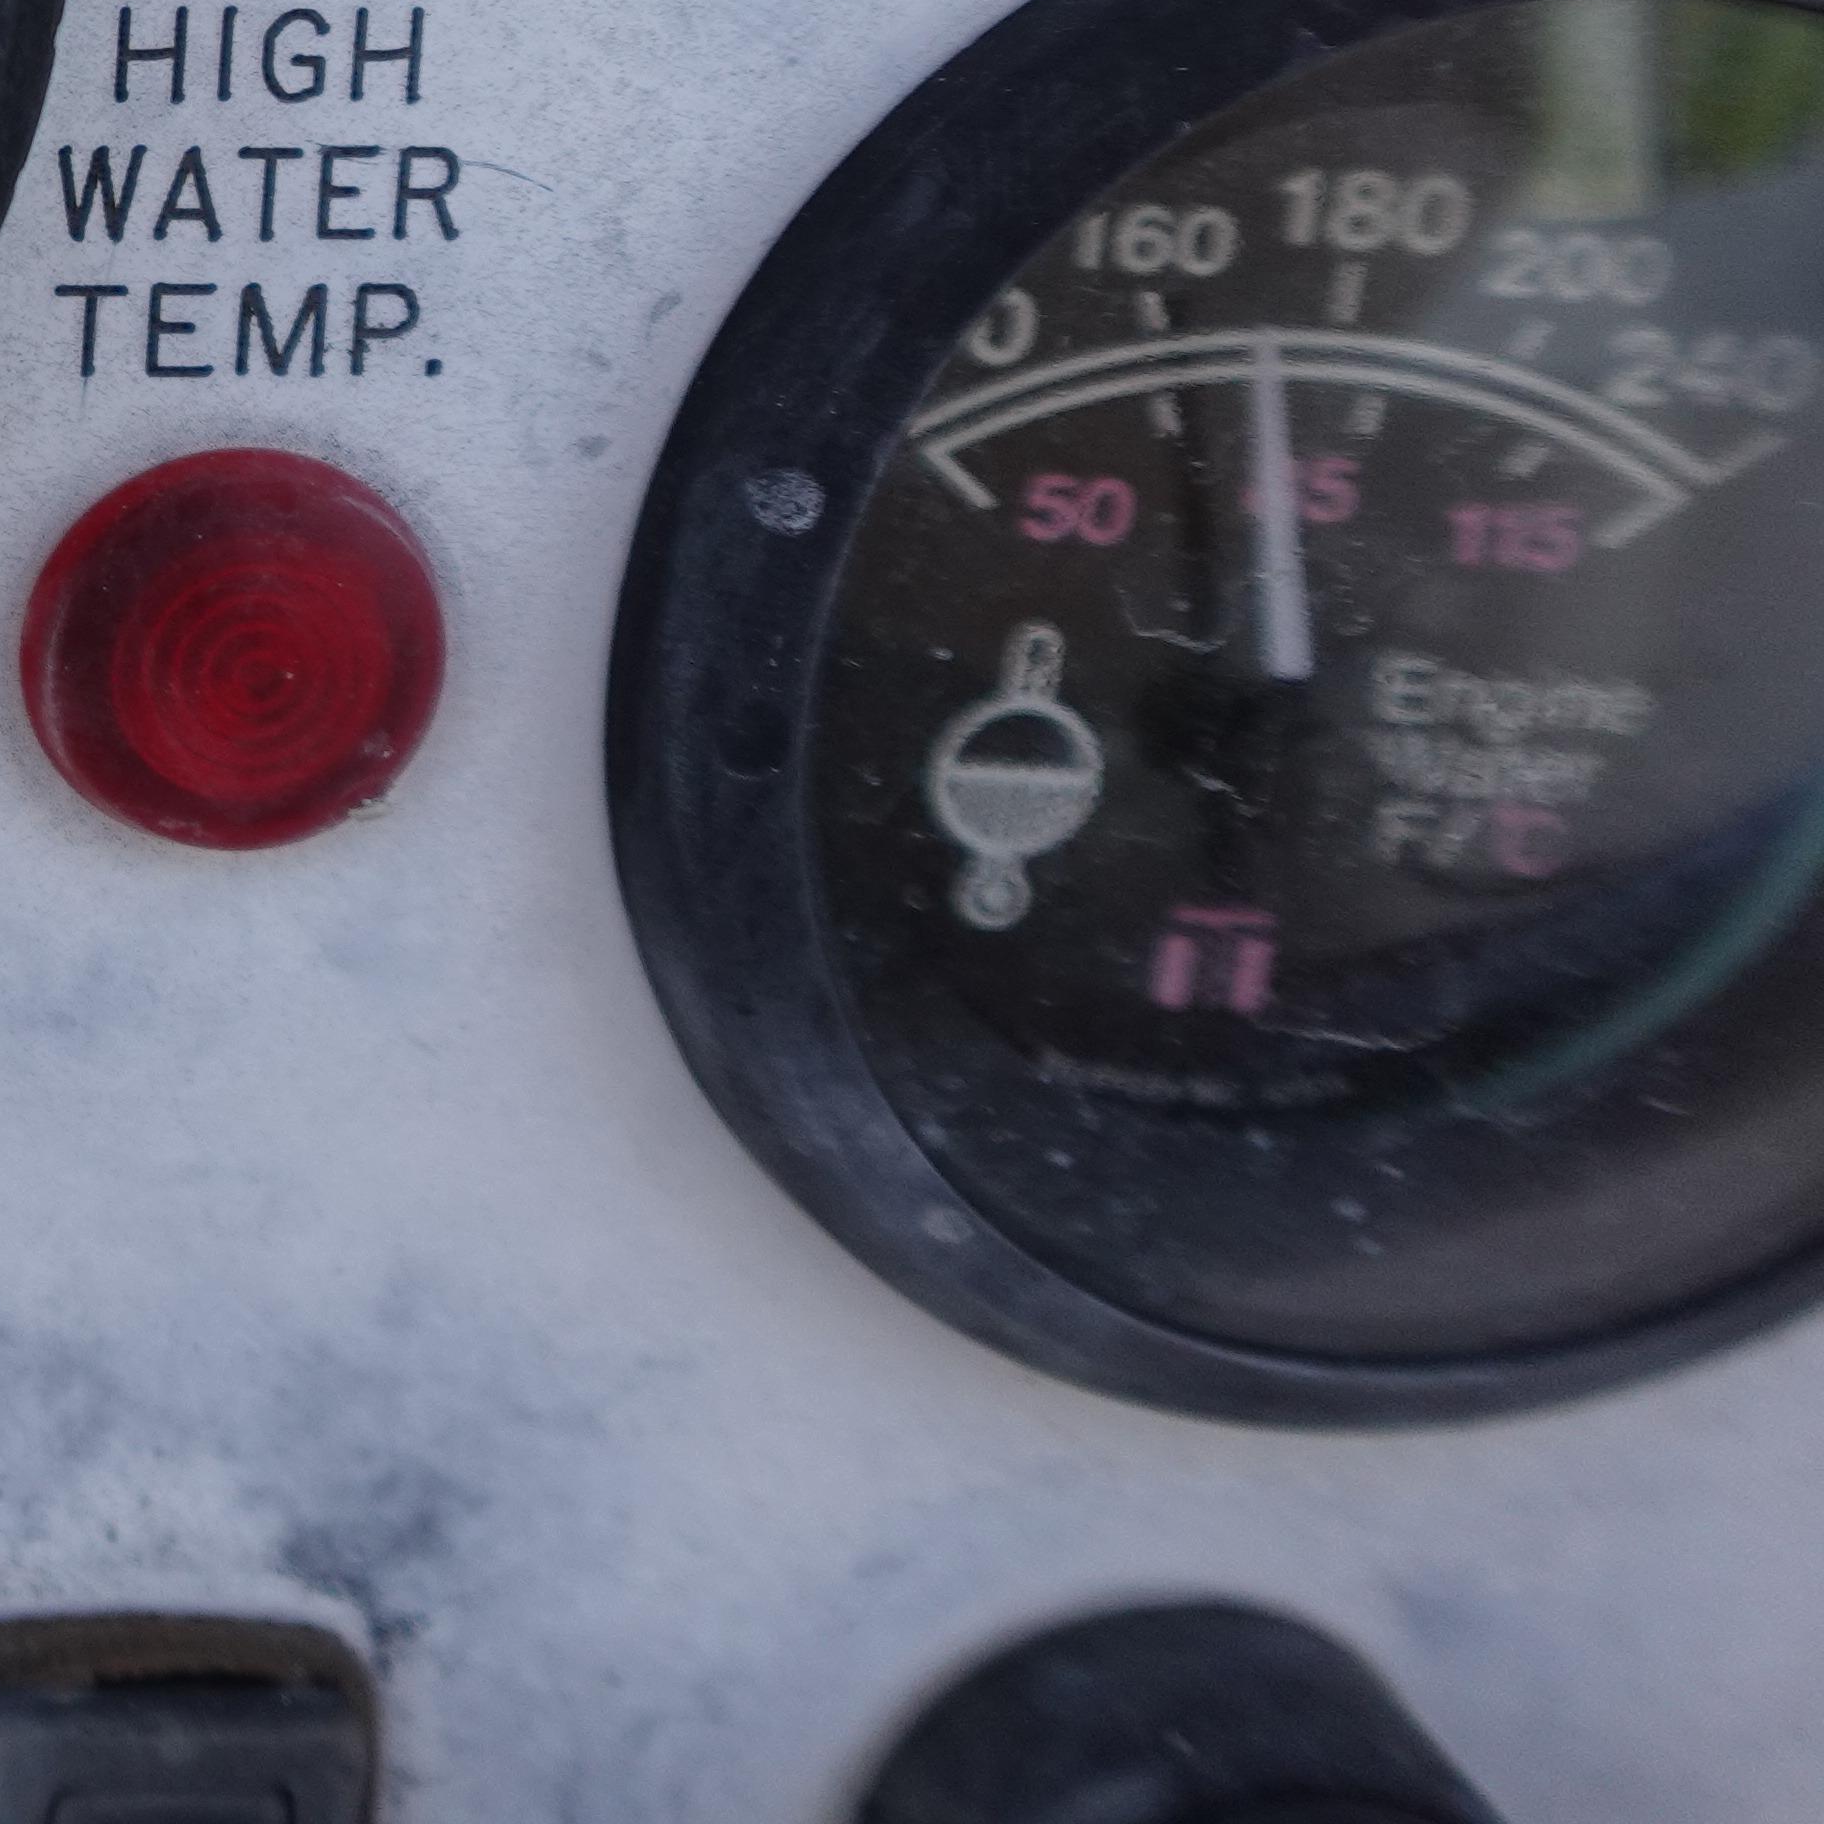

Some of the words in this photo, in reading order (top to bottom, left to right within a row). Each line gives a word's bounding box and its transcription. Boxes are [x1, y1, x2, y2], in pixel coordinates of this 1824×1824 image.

[114, 5, 424, 105] HIGH
[58, 144, 460, 243] WATER
[1279, 167, 1472, 256] 180
[1073, 203, 1240, 276] 160
[1482, 230, 1673, 304] 200
[54, 282, 442, 378] TEMP.
[1018, 472, 1137, 546] 50
